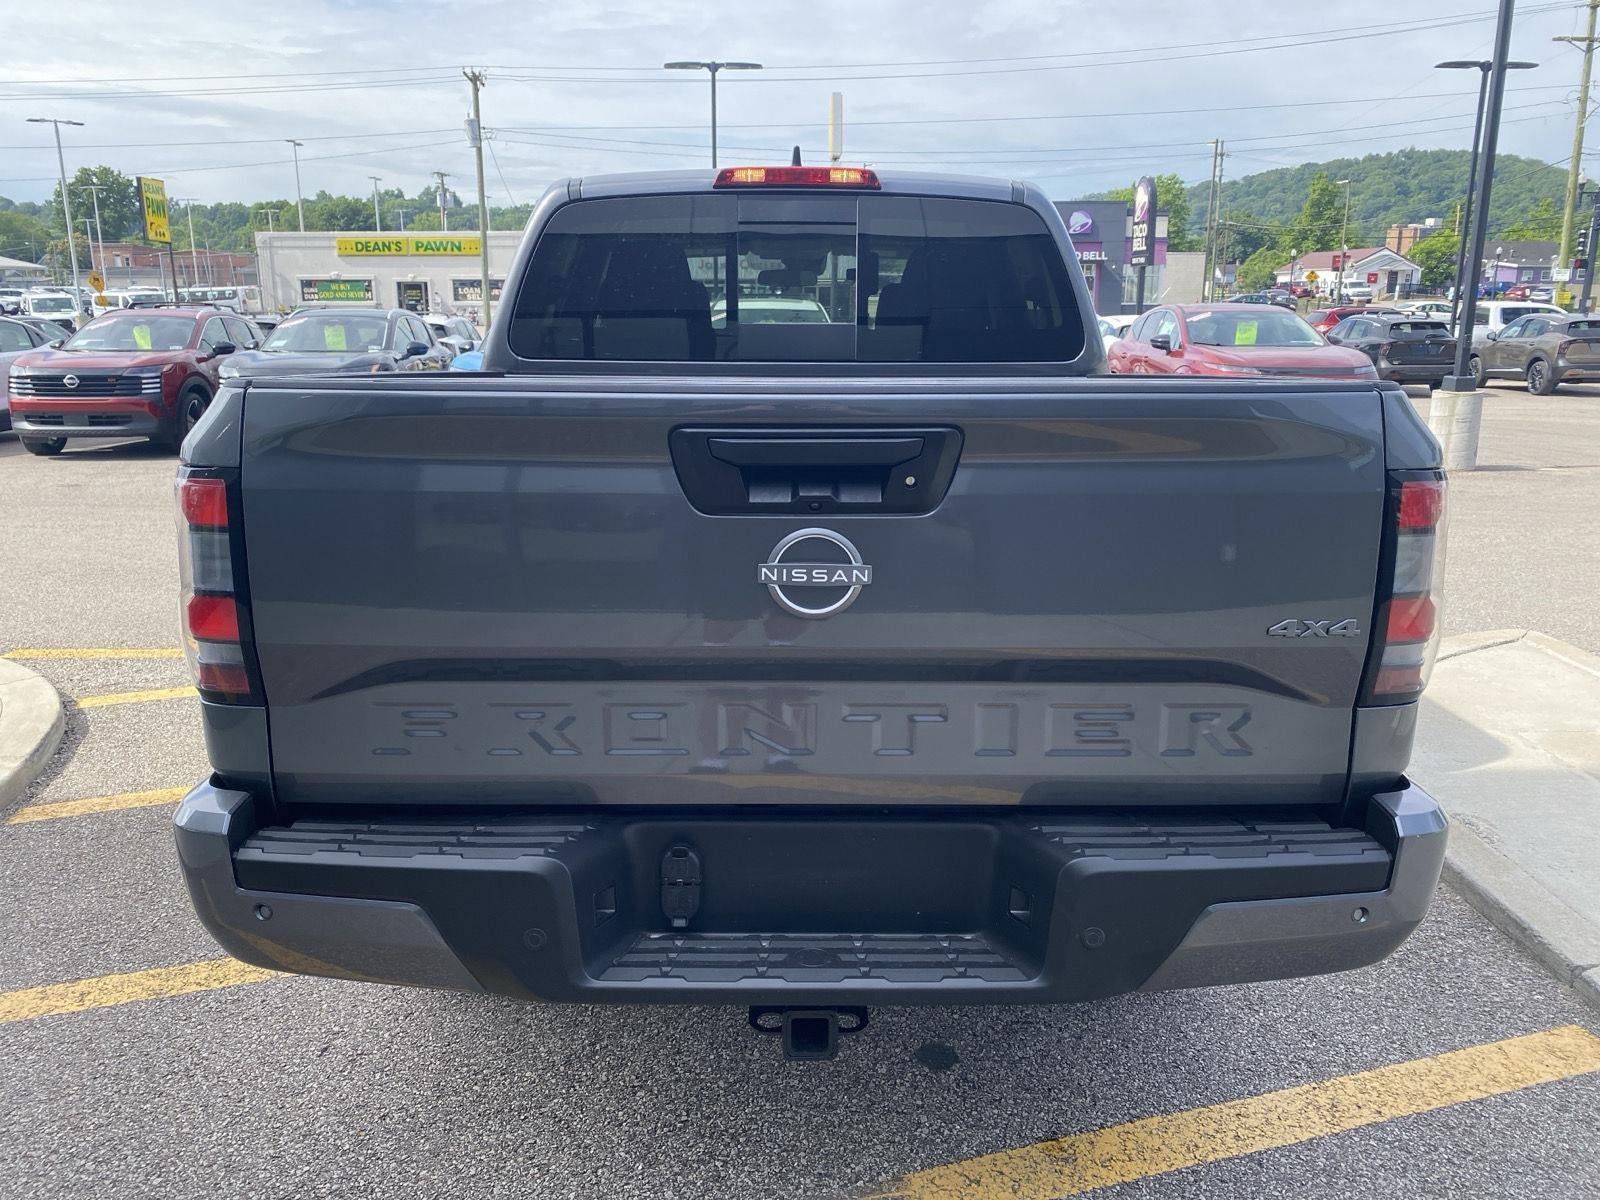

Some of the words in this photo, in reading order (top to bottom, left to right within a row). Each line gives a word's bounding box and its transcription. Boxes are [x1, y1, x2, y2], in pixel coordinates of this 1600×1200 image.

[145, 196, 167, 218] PAWN
[1133, 224, 1147, 238] TACO
[354, 240, 402, 252] DEAN'S
[415, 240, 462, 252] PAWN
[1133, 238, 1147, 252] BELL
[1082, 251, 1108, 261] BELL
[319, 290, 335, 299] GOLD
[761, 567, 869, 583] NISSAN
[369, 701, 1253, 757] FRONTIER
